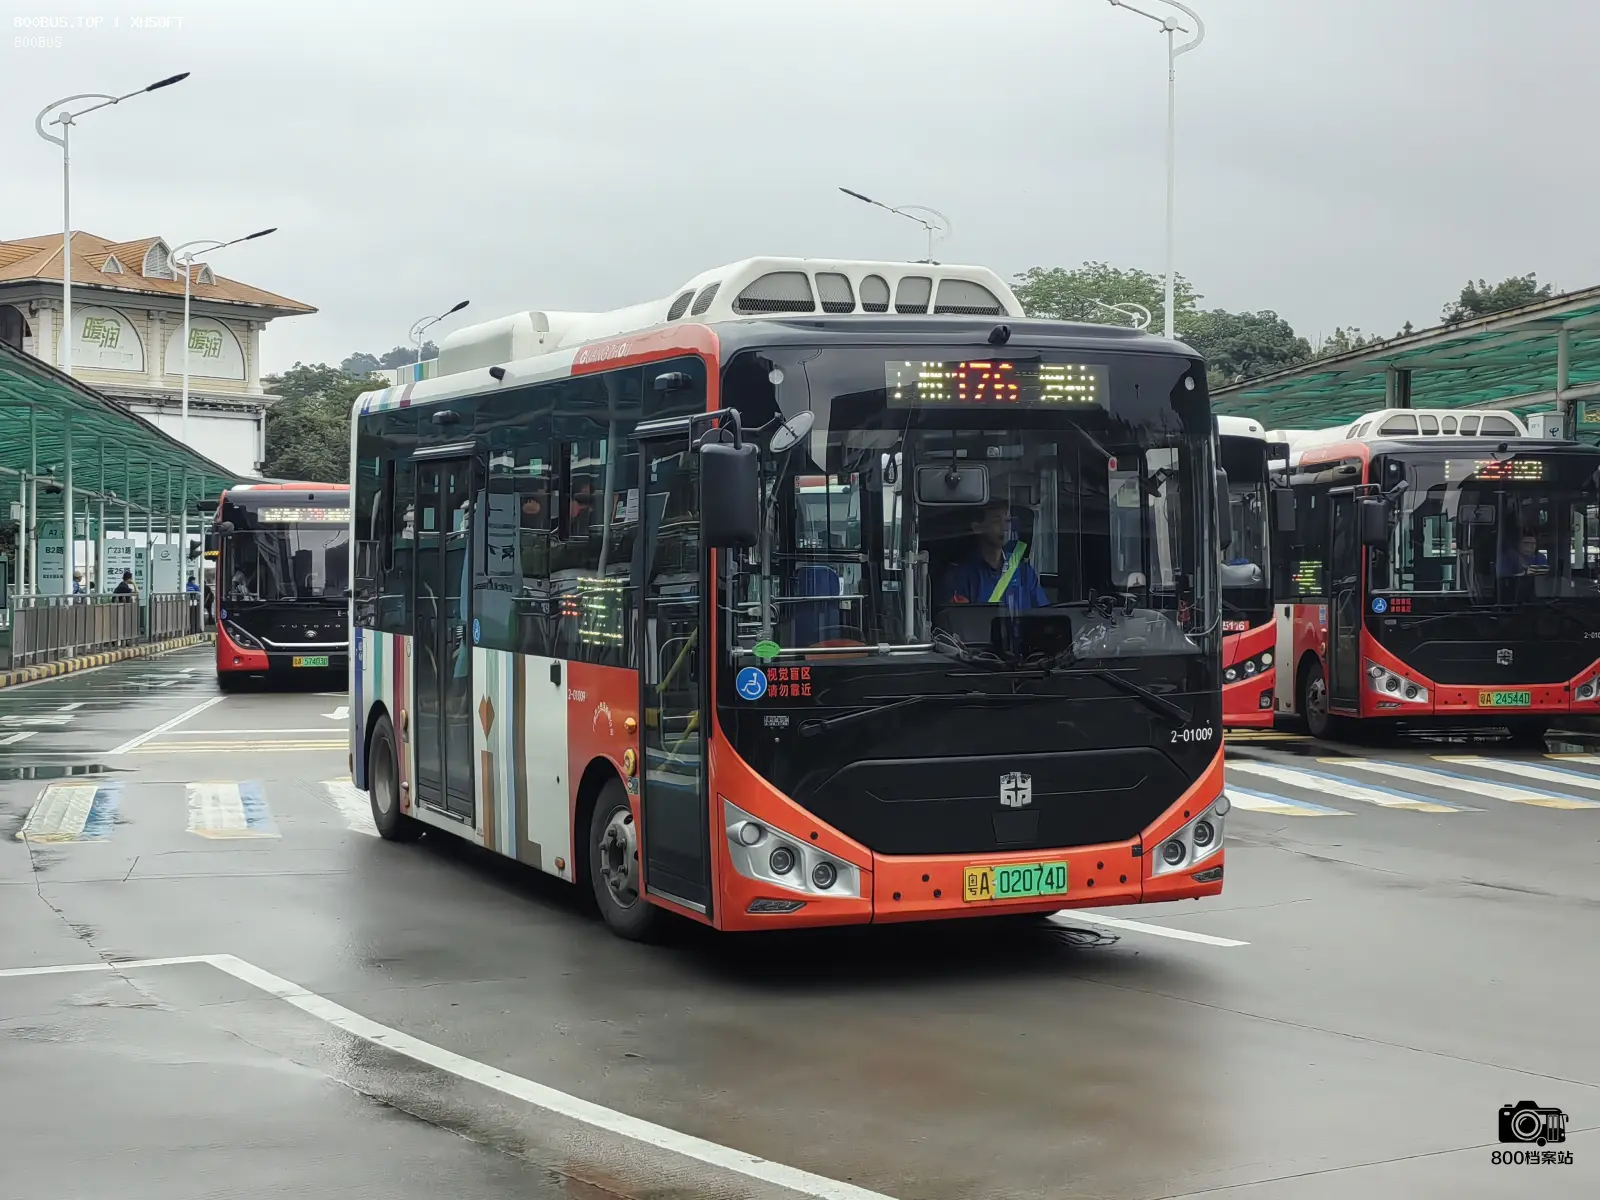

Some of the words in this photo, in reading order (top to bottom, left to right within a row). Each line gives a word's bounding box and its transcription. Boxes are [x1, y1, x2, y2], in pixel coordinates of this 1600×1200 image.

[82, 316, 121, 349] 暖润
[767, 667, 811, 681] 视觉盲区
[767, 683, 812, 697] 请勿靠近
[1170, 727, 1213, 743] 2-01009
